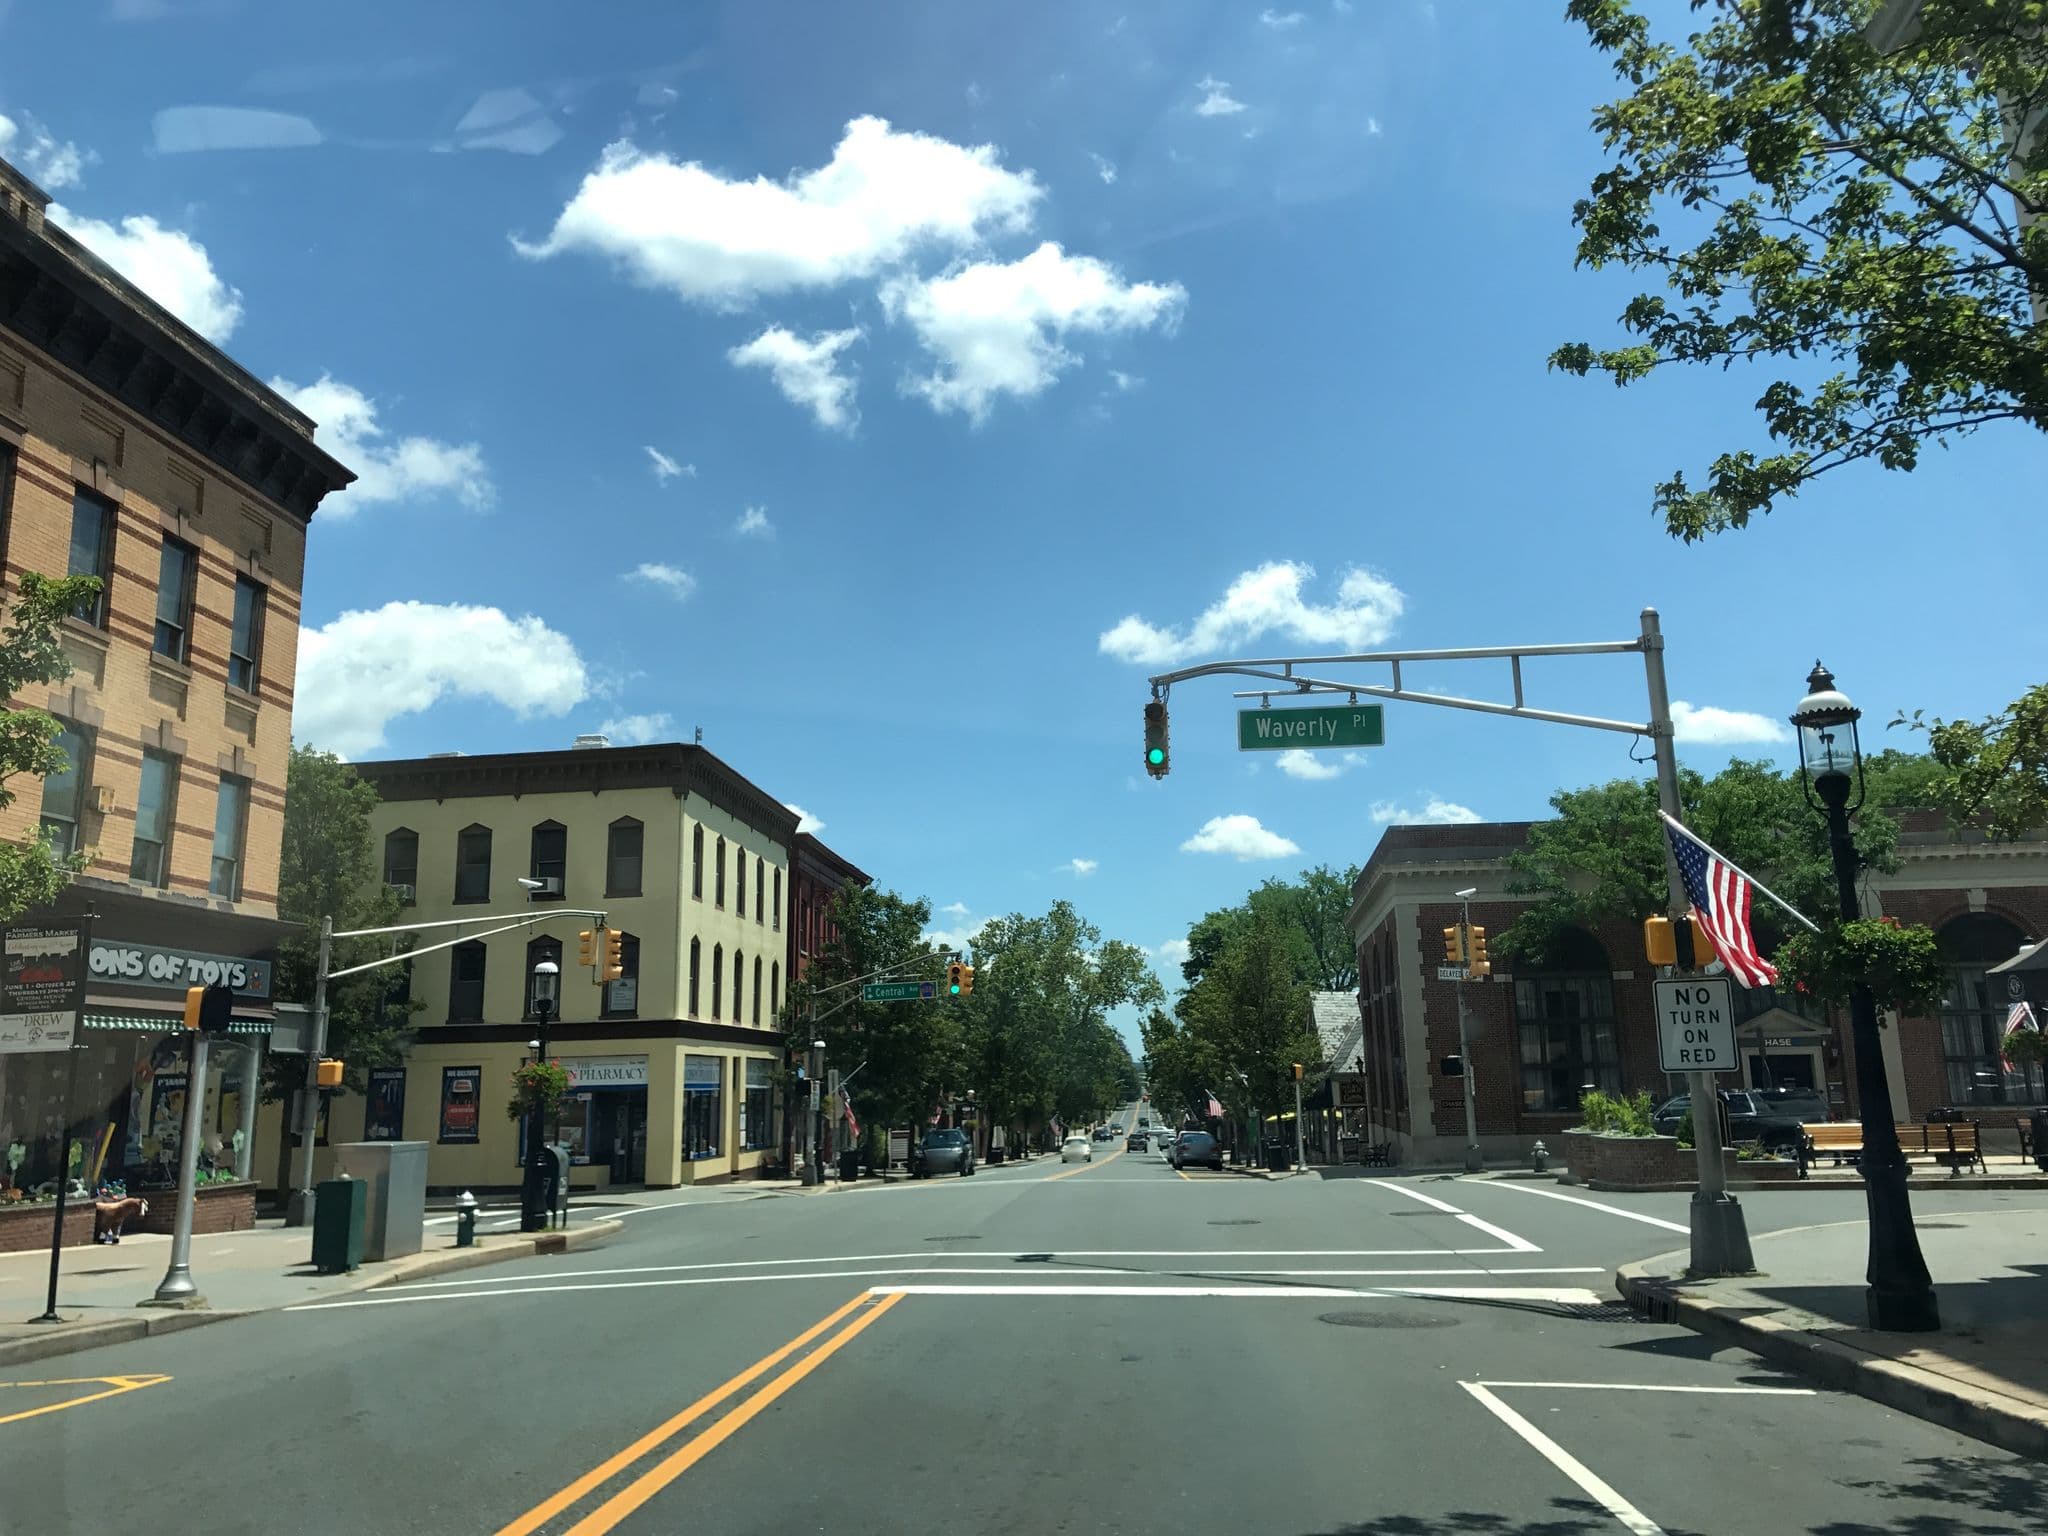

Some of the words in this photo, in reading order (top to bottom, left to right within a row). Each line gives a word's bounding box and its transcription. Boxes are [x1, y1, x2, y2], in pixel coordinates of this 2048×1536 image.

[1255, 716, 1338, 742] Waverly
[1353, 714, 1366, 728] Pl
[6, 931, 43, 939] FARMERS
[45, 929, 79, 937] MARKET
[89, 946, 144, 977] ONS
[148, 953, 184, 980] OF
[187, 958, 246, 987] TOYS
[35, 981, 64, 989] OCTOBER
[875, 987, 905, 997] Central
[1674, 987, 1710, 1006] NO
[24, 1013, 64, 1027] DREW
[1669, 1010, 1720, 1025] TURN
[1684, 1029, 1709, 1044] ON
[1765, 1038, 1792, 1046] HASE
[1680, 1048, 1716, 1063] RED
[580, 1067, 646, 1081] PHARMACY
